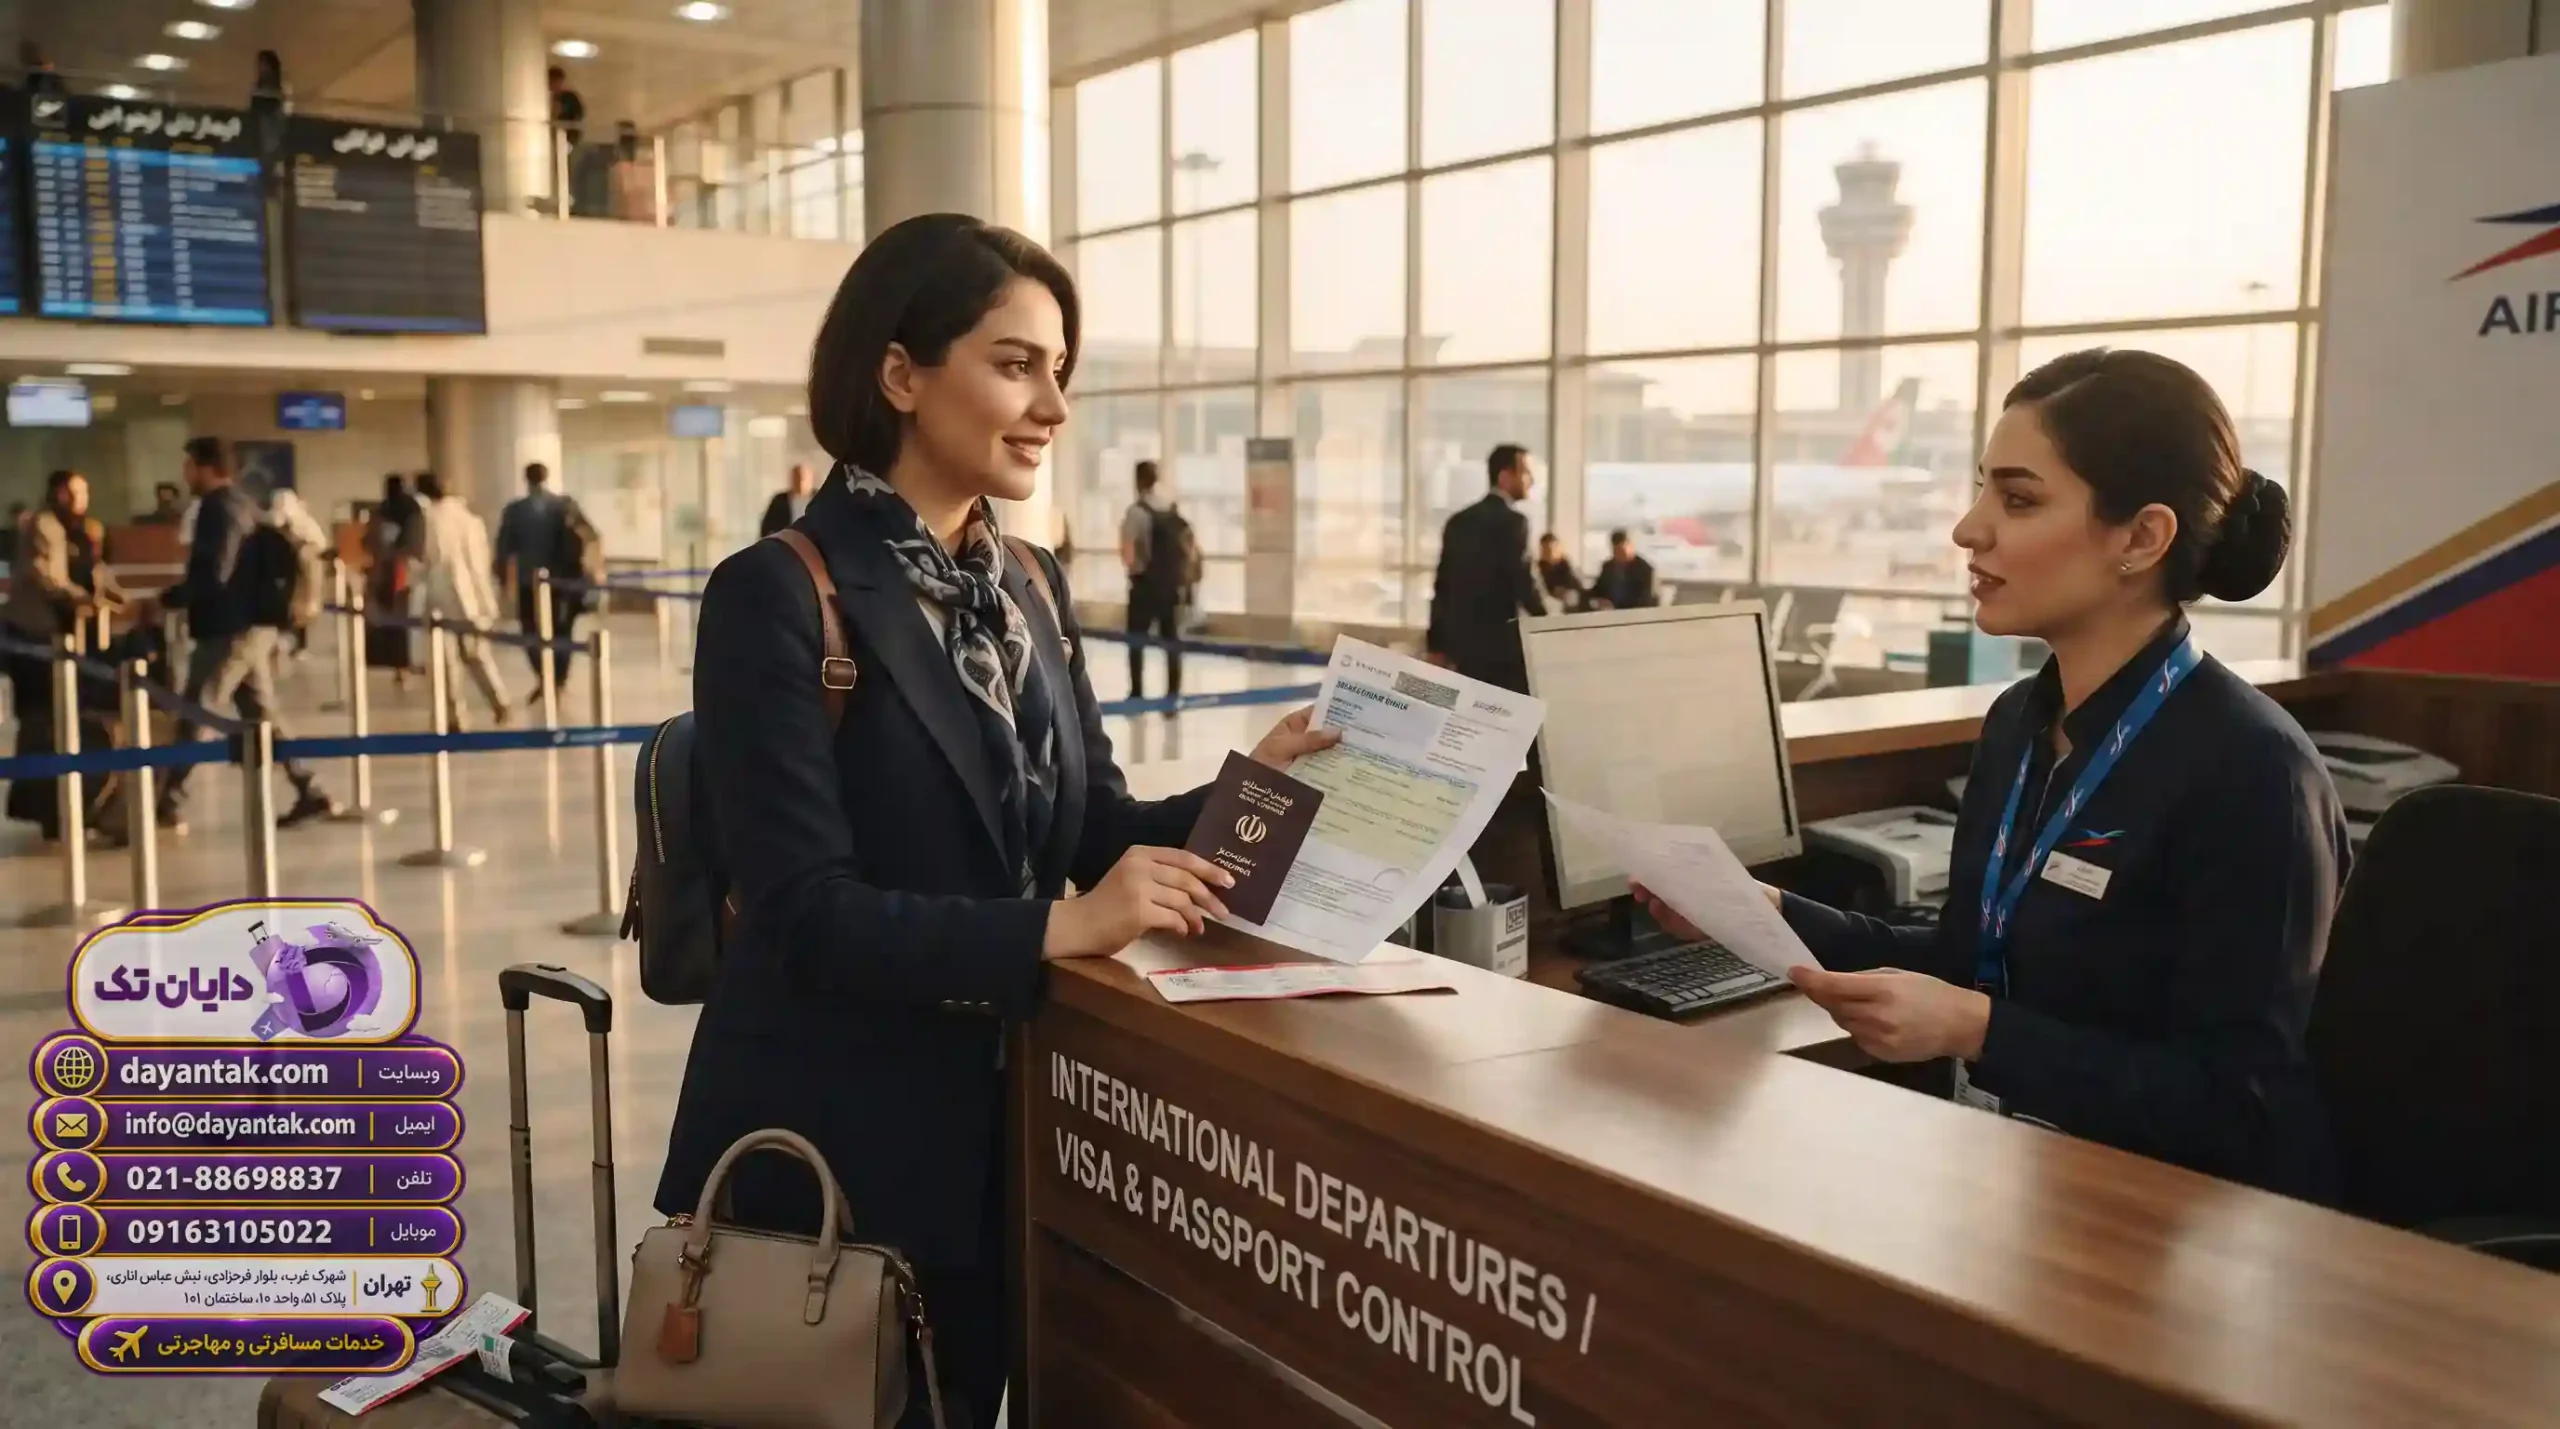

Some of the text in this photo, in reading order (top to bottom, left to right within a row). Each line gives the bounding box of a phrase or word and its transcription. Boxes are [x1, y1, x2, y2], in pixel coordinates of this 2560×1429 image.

[1051, 1051, 1597, 1354] INTERNATIONAL DEPARTURES /
[1056, 1127, 1535, 1428] VISA & PASSPORT CONTROL
